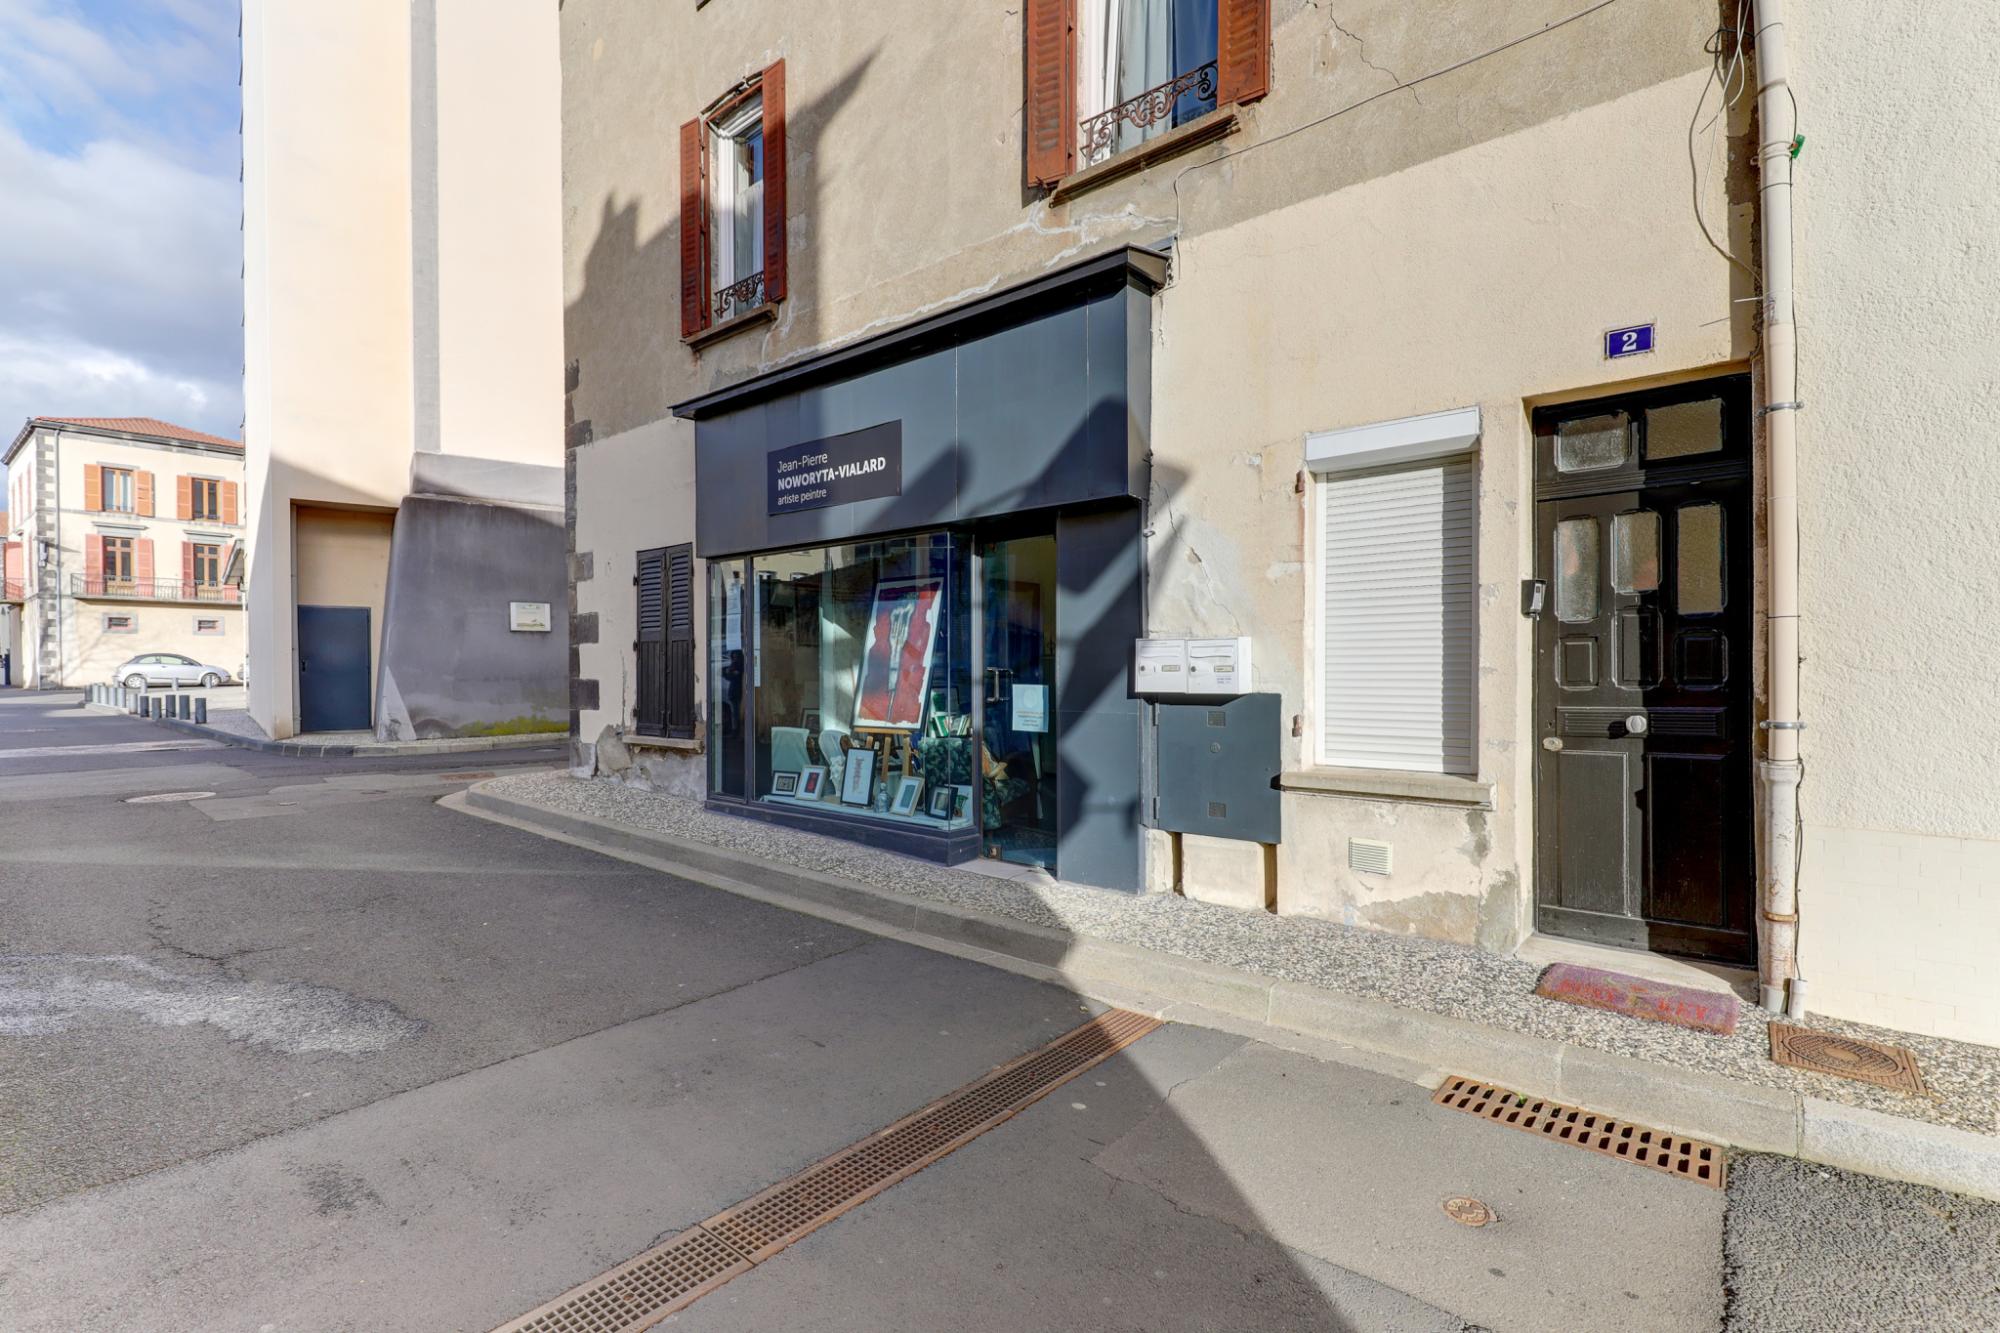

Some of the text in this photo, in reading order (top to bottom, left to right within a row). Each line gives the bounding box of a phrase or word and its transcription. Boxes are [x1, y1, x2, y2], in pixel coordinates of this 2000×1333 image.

[1622, 332, 1637, 352] 2
[777, 453, 828, 474] Jean-Pierre
[777, 457, 886, 491] NOWORYTA-VIALARD
[777, 488, 827, 506] artiste peintre
